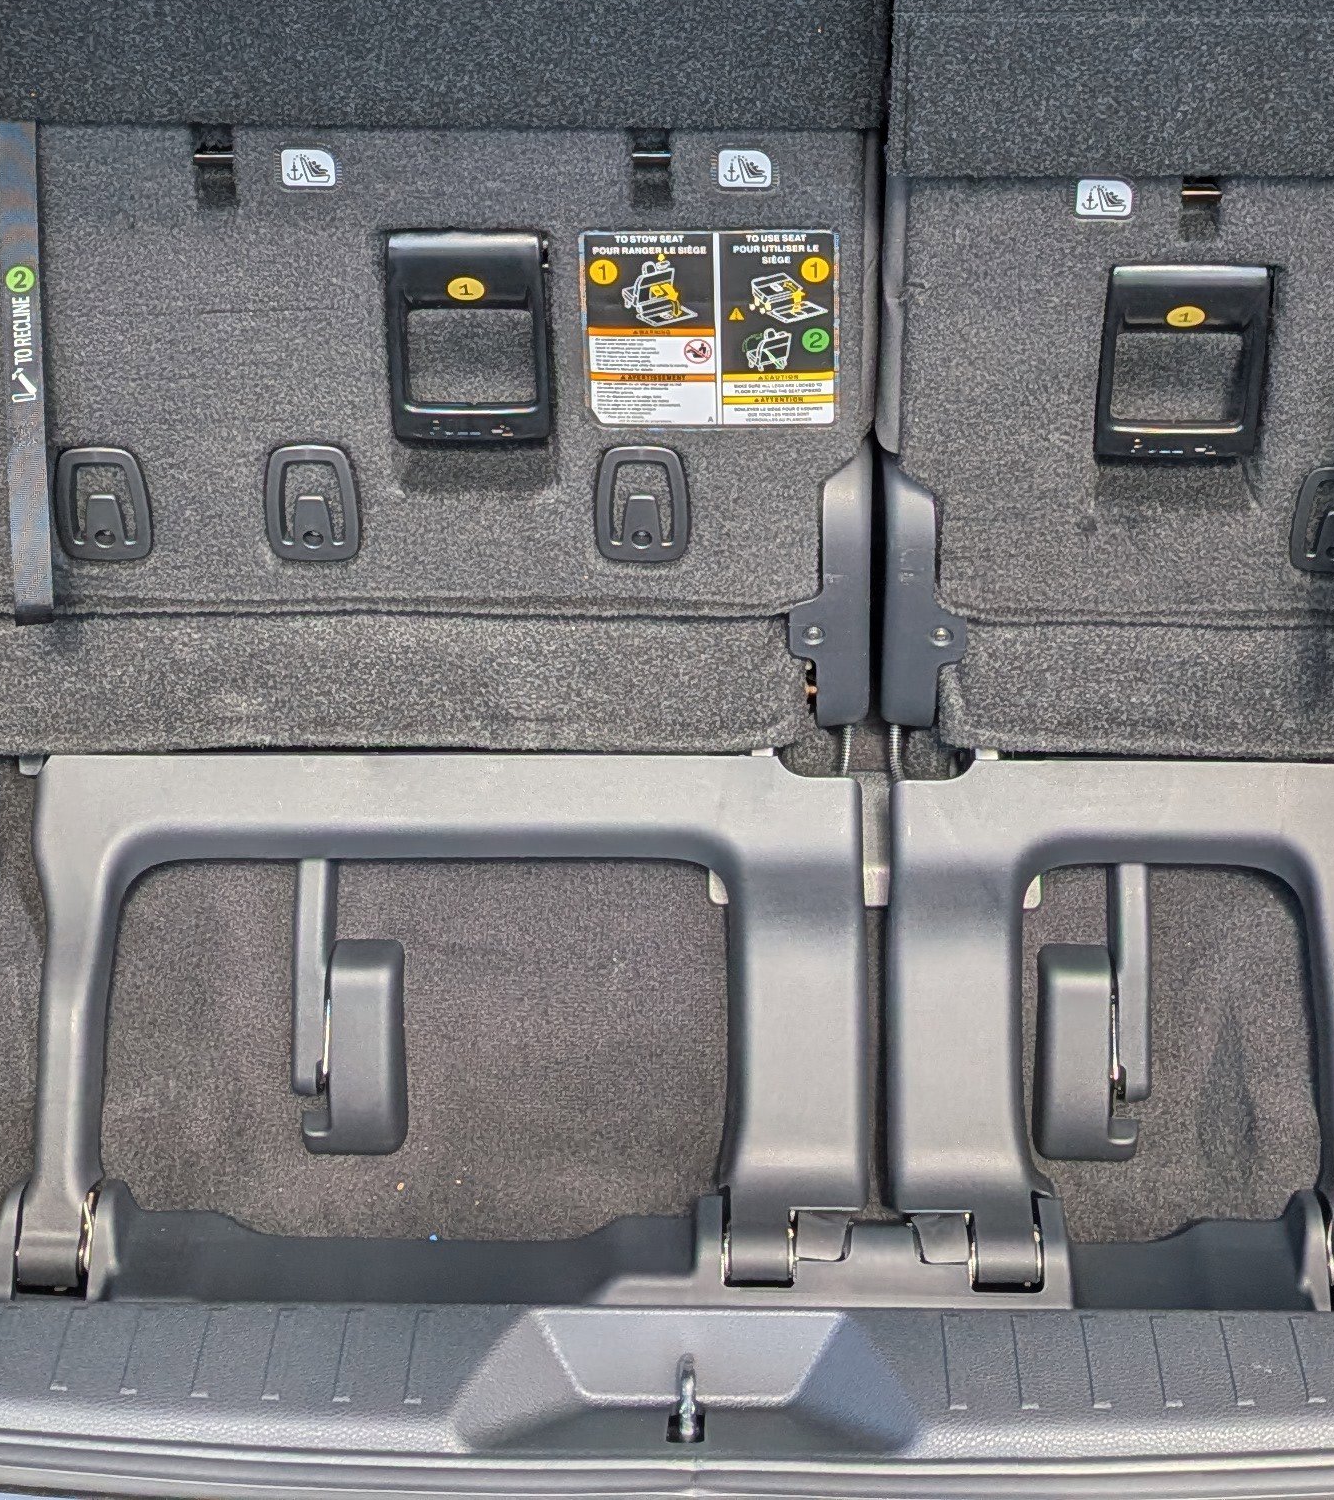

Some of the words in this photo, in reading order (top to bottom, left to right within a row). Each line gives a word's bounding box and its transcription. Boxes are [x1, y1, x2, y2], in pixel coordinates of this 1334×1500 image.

[614, 235, 628, 243] TO
[629, 235, 658, 243] STOW
[659, 235, 685, 243] SEAT
[746, 234, 759, 242] TO
[761, 234, 780, 242] USE
[782, 234, 807, 242] SEAT
[592, 246, 620, 255] POUR
[621, 246, 662, 255] RANGER
[663, 246, 676, 255] LE
[732, 245, 760, 253] POUR
[761, 244, 805, 253] UTILISER
[806, 244, 820, 252] LE
[598, 263, 607, 280] 1
[809, 261, 818, 279] 1
[13, 270, 27, 288] 2
[458, 283, 474, 296] 1
[12, 296, 33, 348] RECLINE
[1178, 312, 1193, 323] 1
[809, 331, 822, 348] 2
[14, 350, 33, 365] TO
